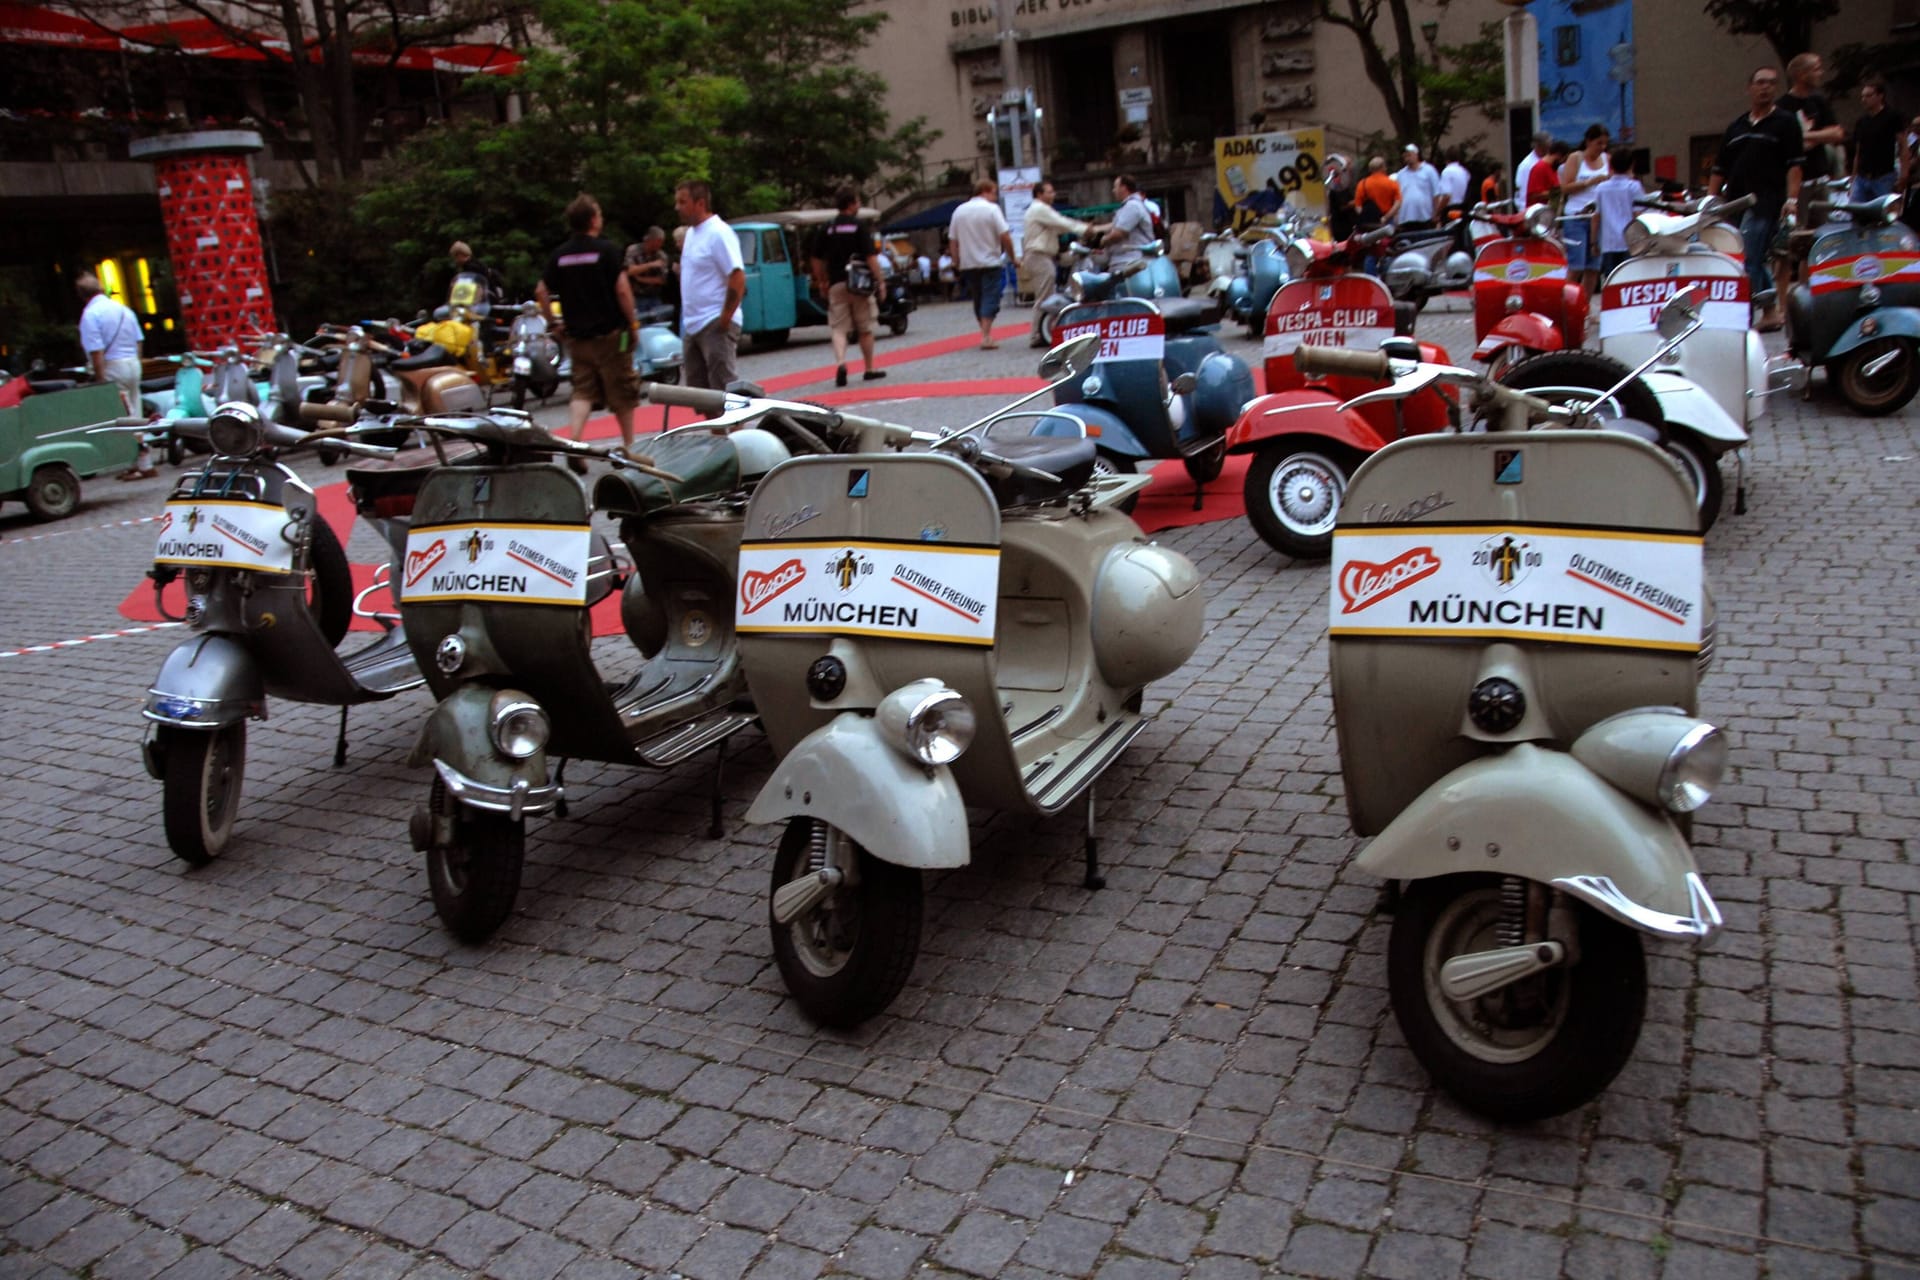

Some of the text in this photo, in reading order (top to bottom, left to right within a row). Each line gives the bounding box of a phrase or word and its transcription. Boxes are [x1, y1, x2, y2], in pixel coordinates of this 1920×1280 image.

[1223, 139, 1267, 157] ADAC
[1277, 309, 1378, 332] VESPA-CLUB
[1303, 330, 1346, 347] WIEN
[159, 539, 223, 558] MÜNCHEN
[508, 540, 579, 581] OLDTIMER FREUNDE
[1472, 551, 1543, 567] 20 00
[432, 570, 527, 593] MÜNCHEN
[743, 560, 806, 613] Vespa
[894, 563, 987, 617] OLDTIMER FREUNDE
[1342, 550, 1441, 613] Vespa
[1569, 553, 1694, 617] OLDTIMER FREUNDE
[783, 597, 918, 628] MÜNCHEN
[1409, 593, 1604, 630] MÜNCHEN
